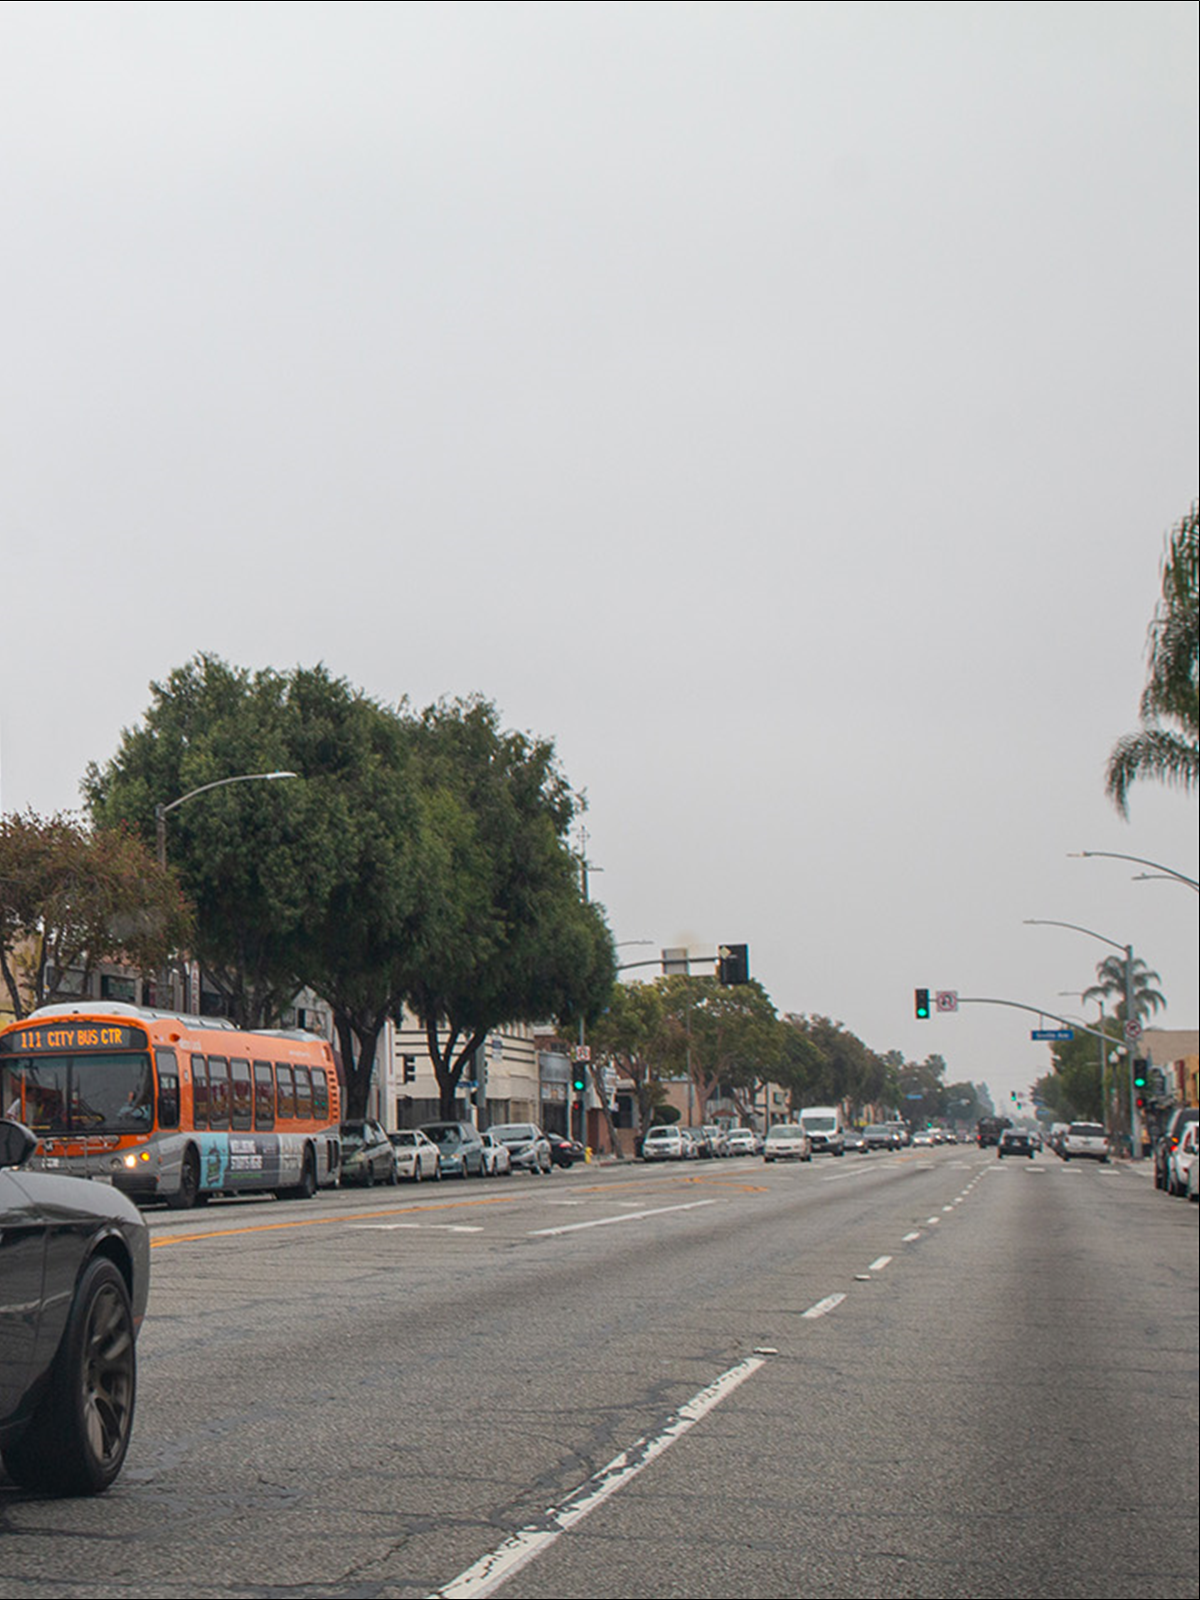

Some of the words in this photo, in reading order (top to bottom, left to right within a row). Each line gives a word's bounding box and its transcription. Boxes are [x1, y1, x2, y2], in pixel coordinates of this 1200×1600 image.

[21, 1031, 42, 1048] 111
[47, 1030, 75, 1047] CITY
[77, 1028, 99, 1046] BUS
[100, 1027, 123, 1045] CTR
